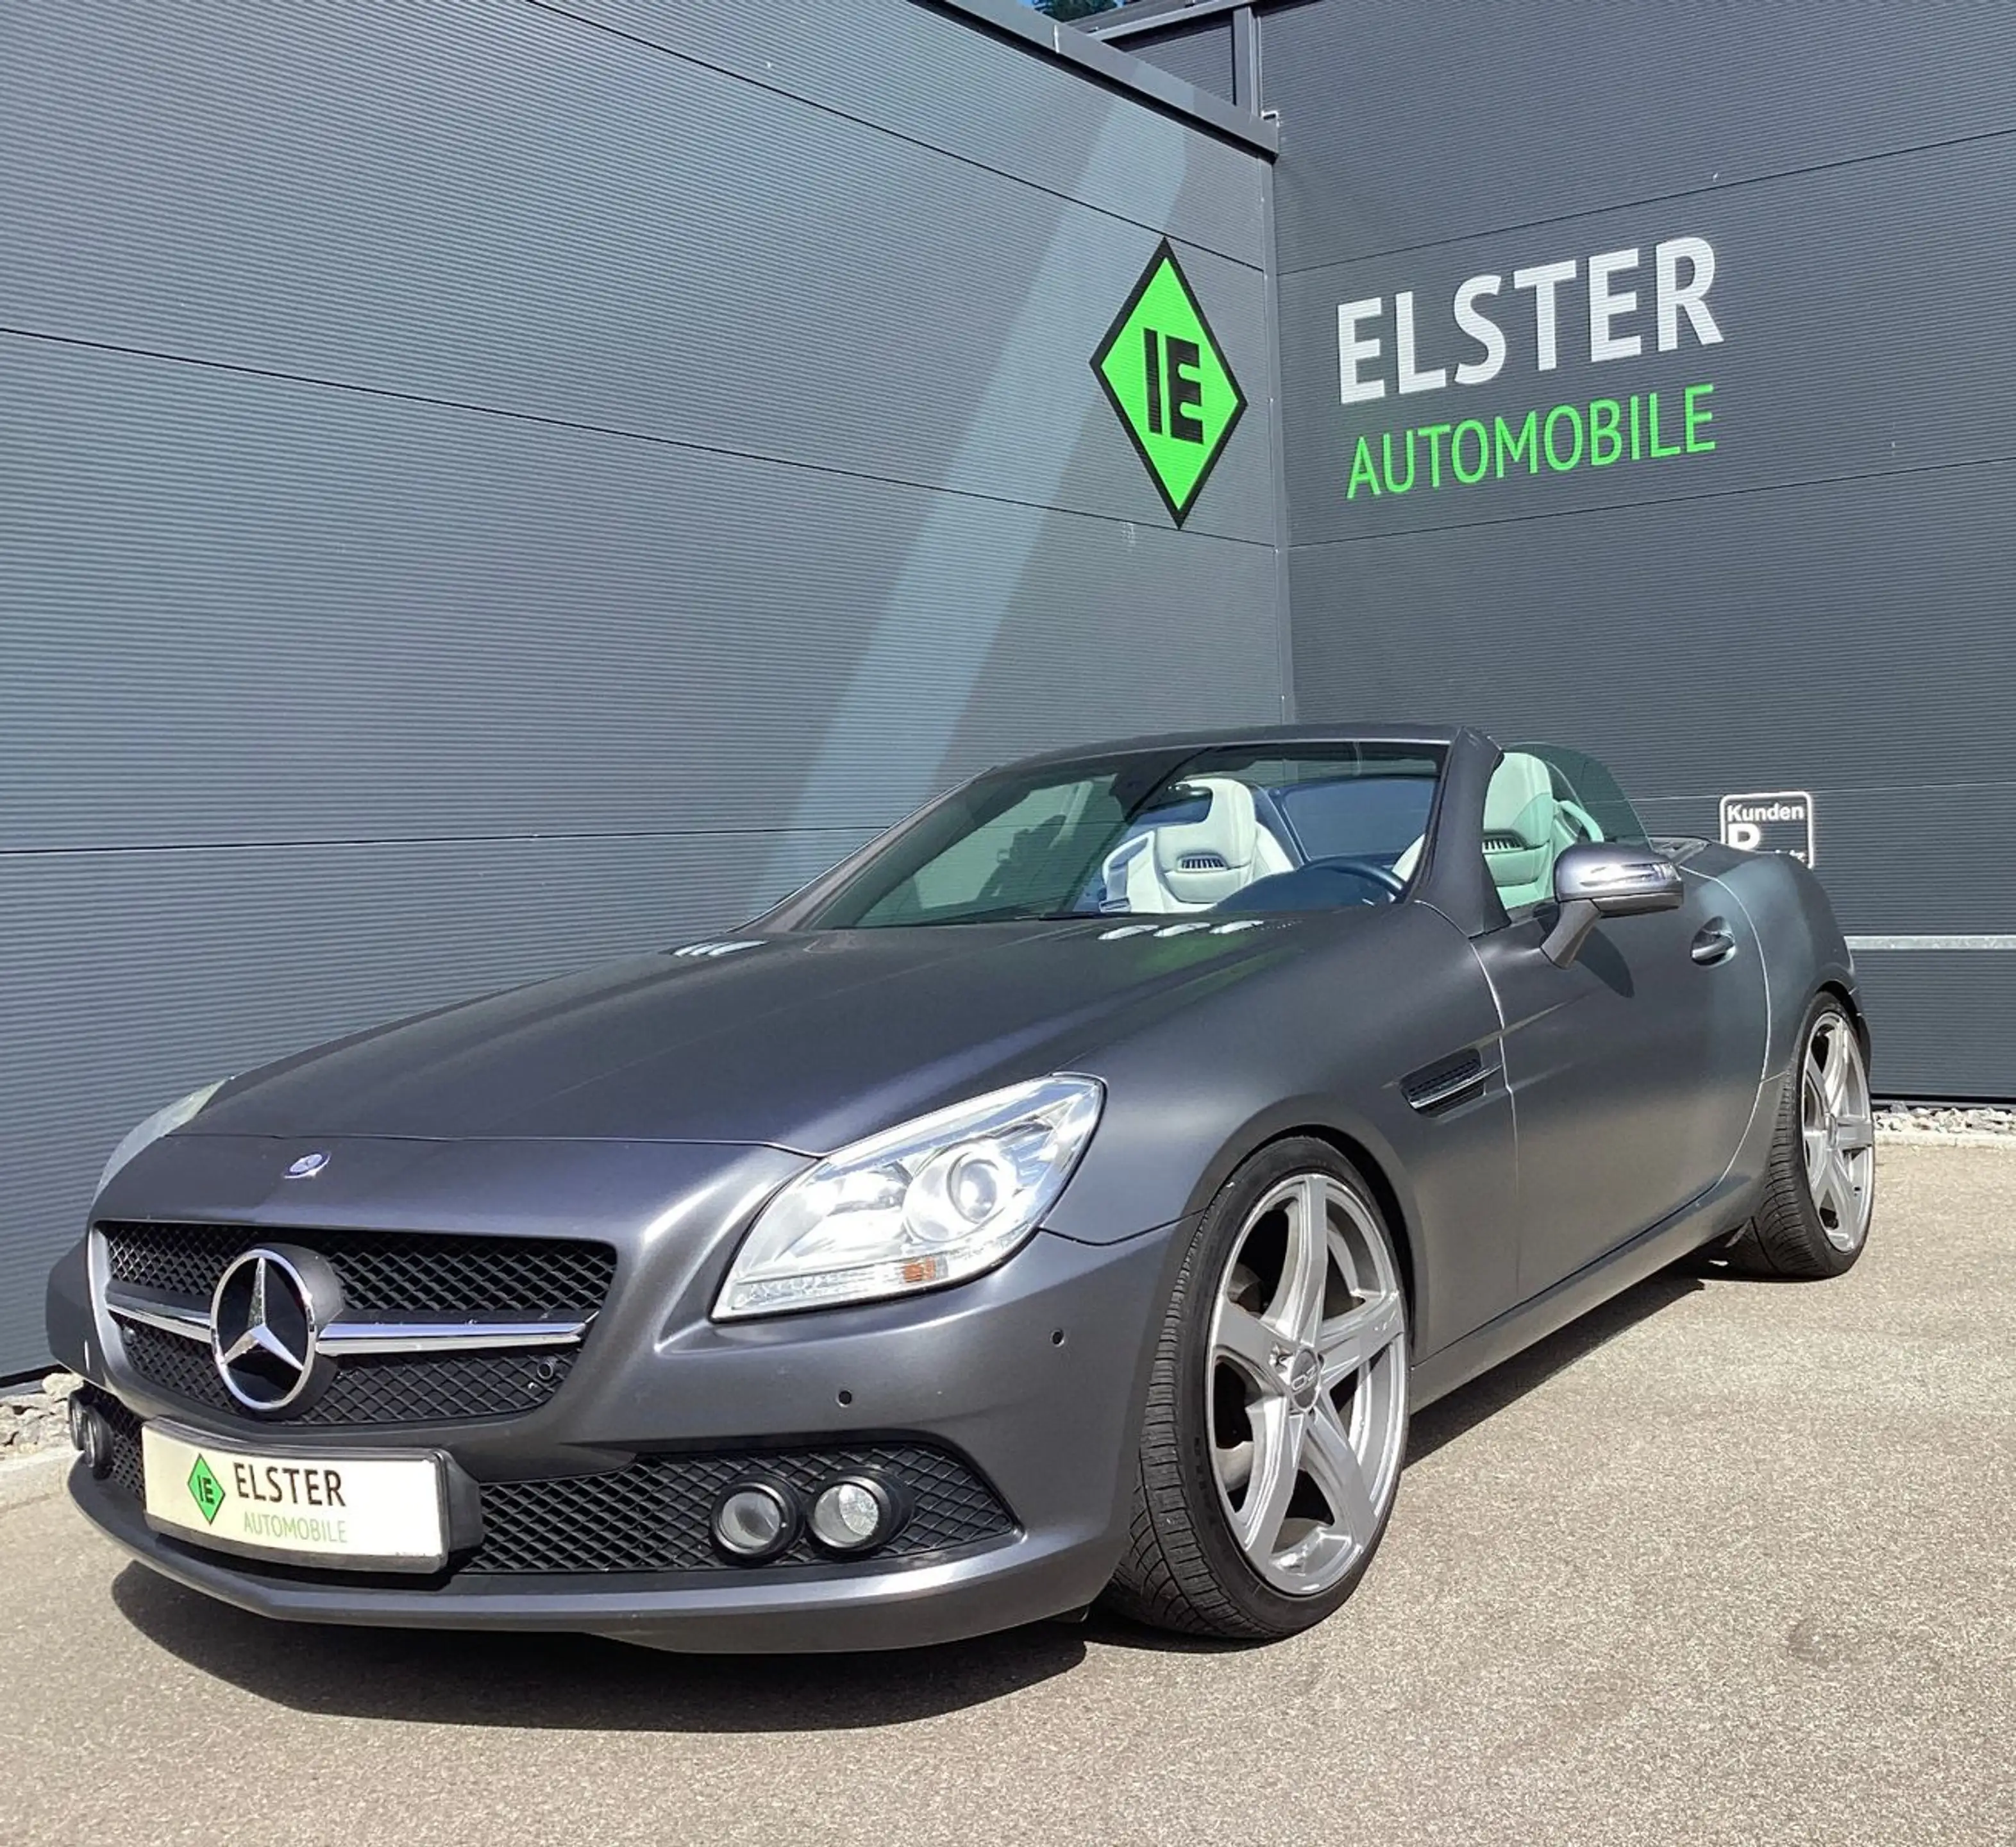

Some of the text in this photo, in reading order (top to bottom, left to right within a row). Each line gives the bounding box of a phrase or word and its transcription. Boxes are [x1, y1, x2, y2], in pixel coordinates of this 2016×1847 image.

[1338, 236, 1723, 404] ELSTER
[1347, 385, 1715, 499] AUTOMOBILE
[1727, 802, 1804, 822] Kunden
[233, 1463, 346, 1506] ELSTER
[244, 1512, 347, 1542] AUTOMOBILE
